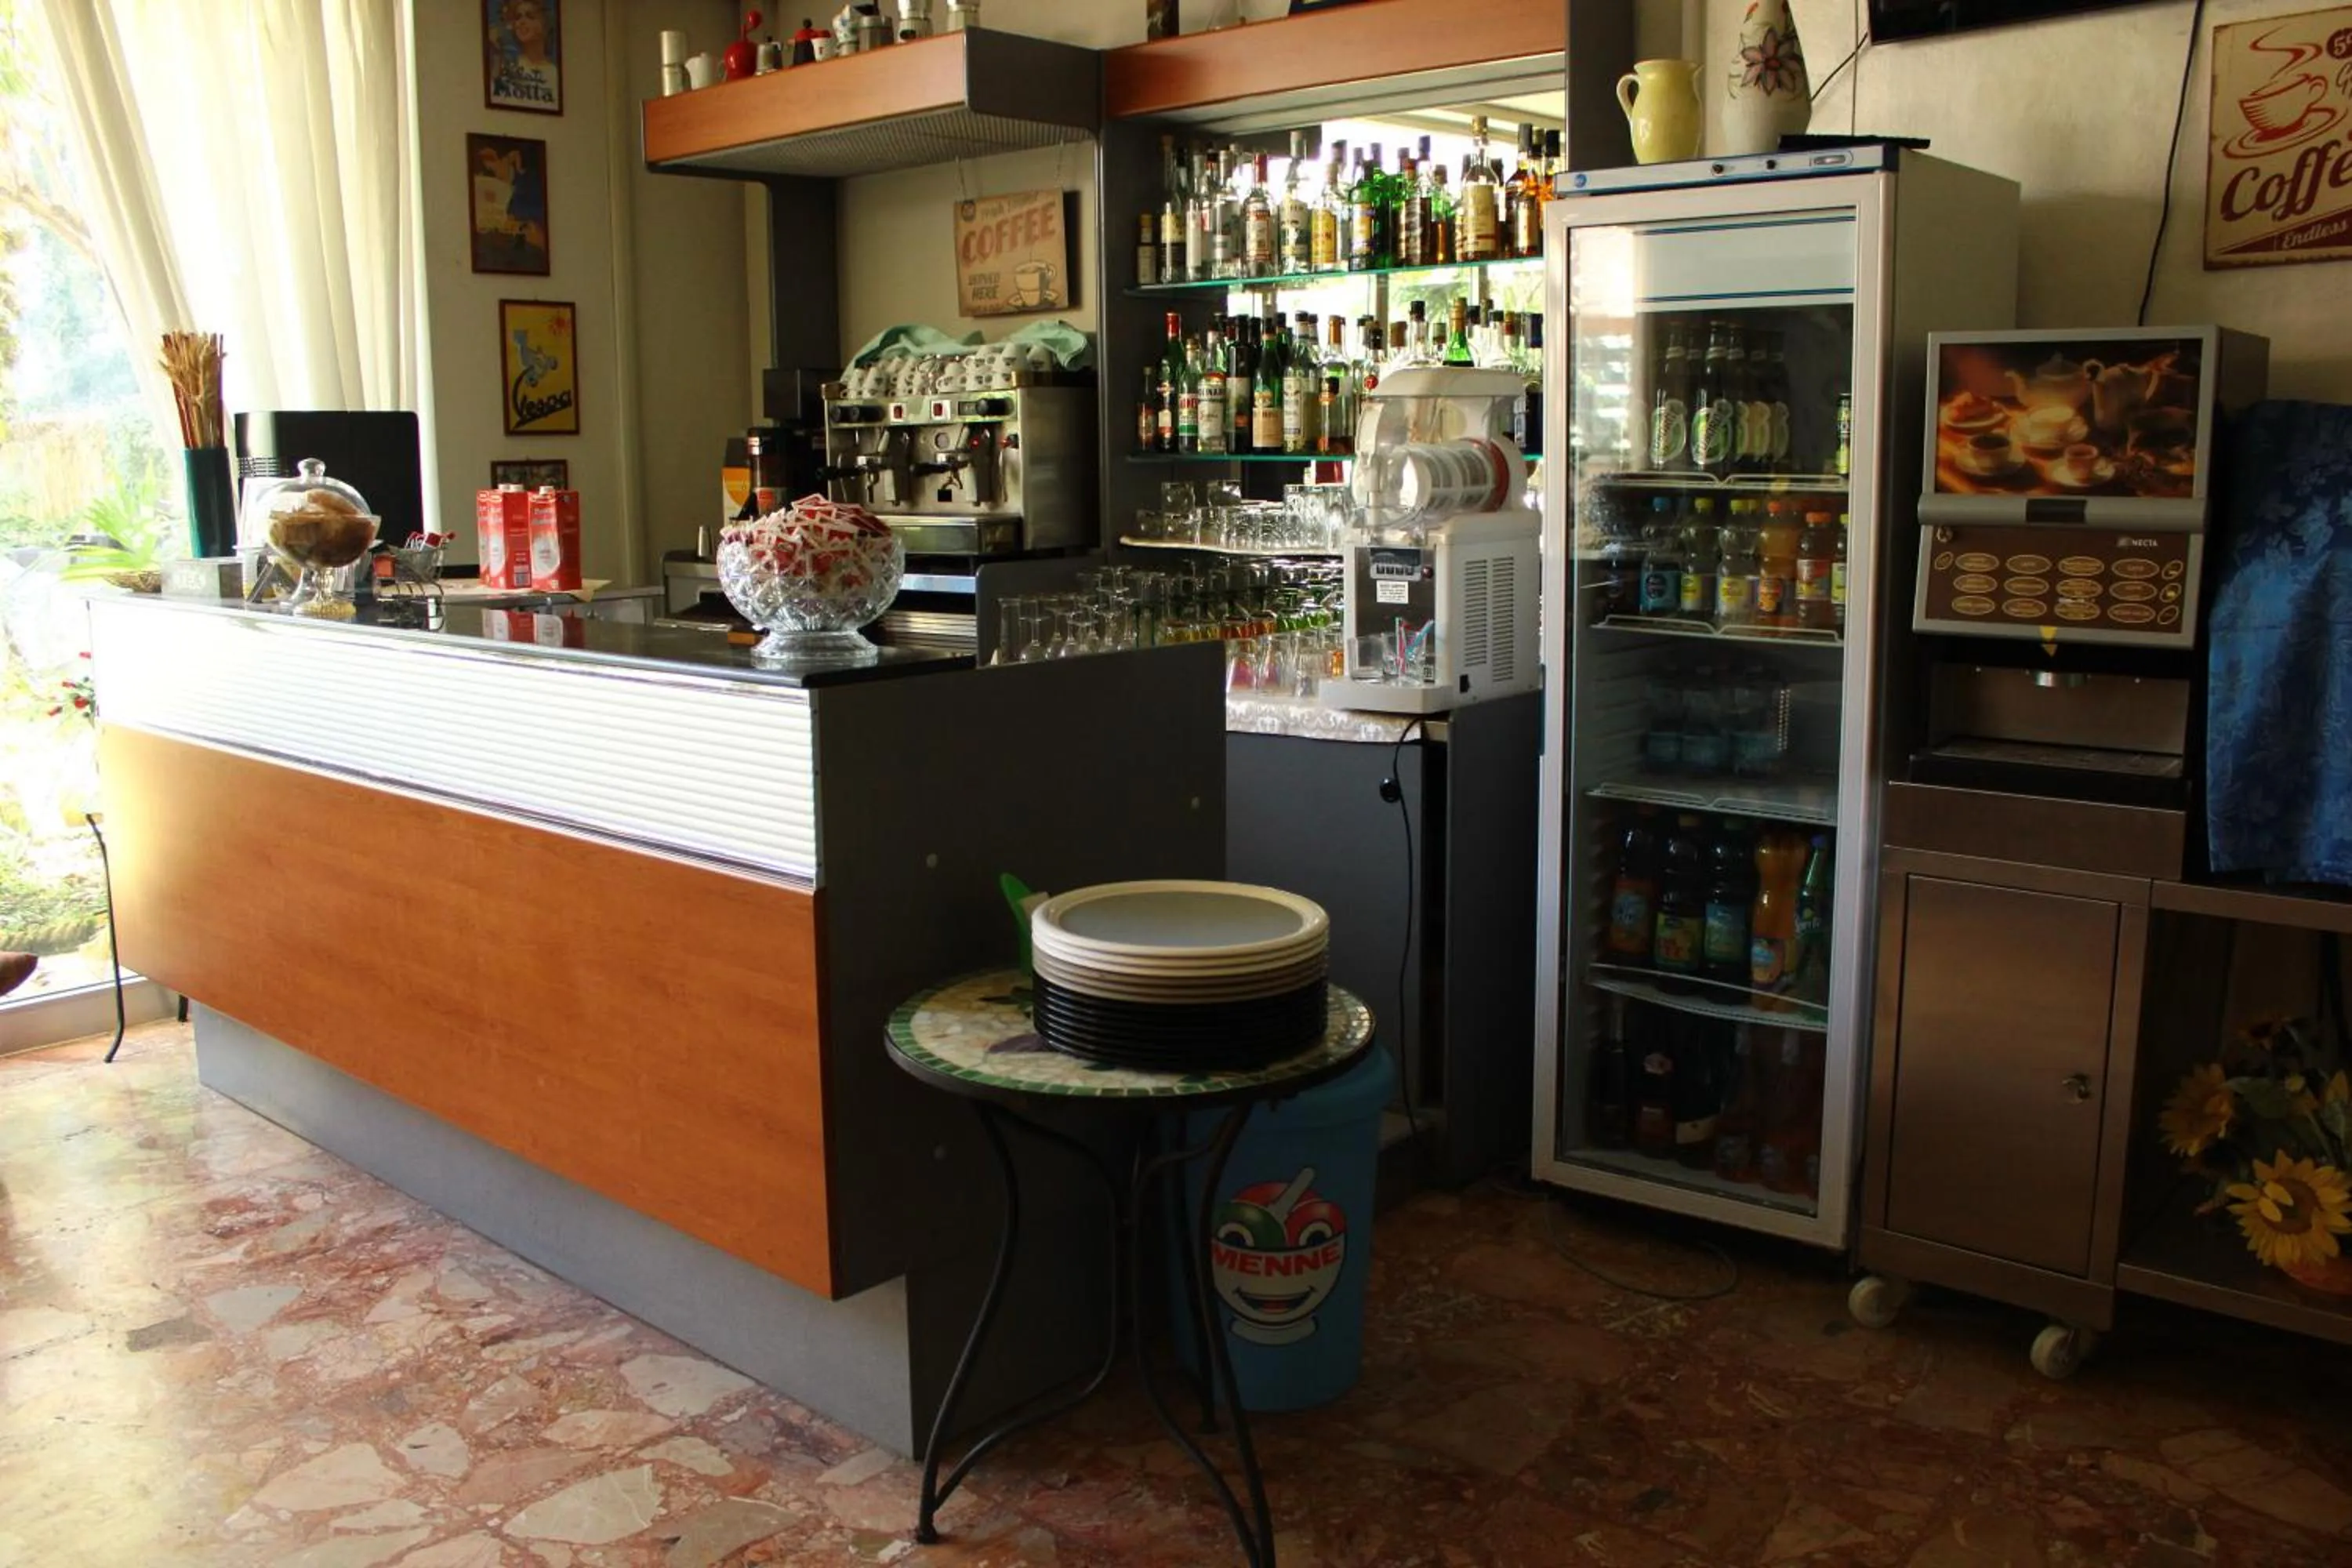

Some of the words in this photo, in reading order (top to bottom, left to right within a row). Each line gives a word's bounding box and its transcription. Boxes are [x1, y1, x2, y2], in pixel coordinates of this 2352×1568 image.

[961, 201, 1057, 268] COFFEE
[2281, 220, 2349, 249] Endless
[513, 368, 572, 430] Vespa
[2132, 539, 2158, 547] NECTA
